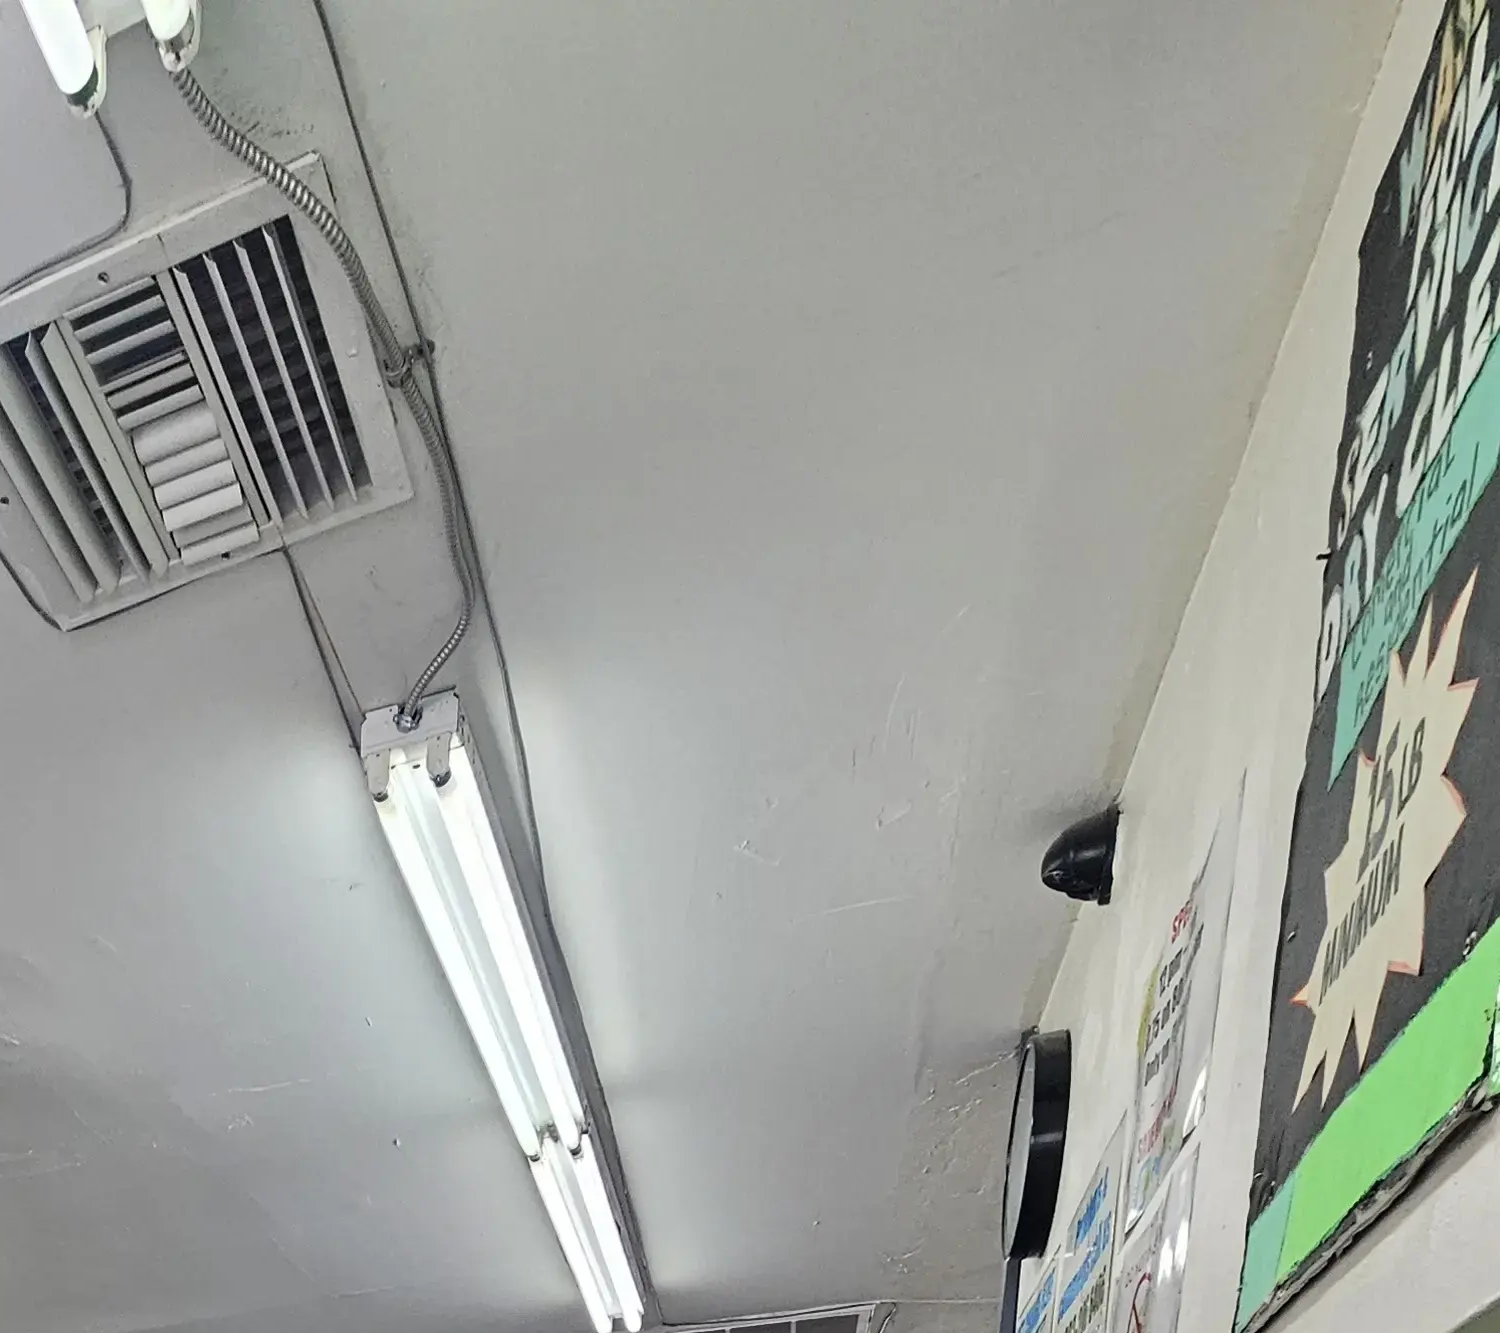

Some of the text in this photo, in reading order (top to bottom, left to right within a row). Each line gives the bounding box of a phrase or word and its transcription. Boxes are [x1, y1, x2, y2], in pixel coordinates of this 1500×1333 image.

[1404, 8, 1500, 318] FOL
[1314, 215, 1500, 705] DRY CLE
[1319, 822, 1404, 1006] MINIMUM
